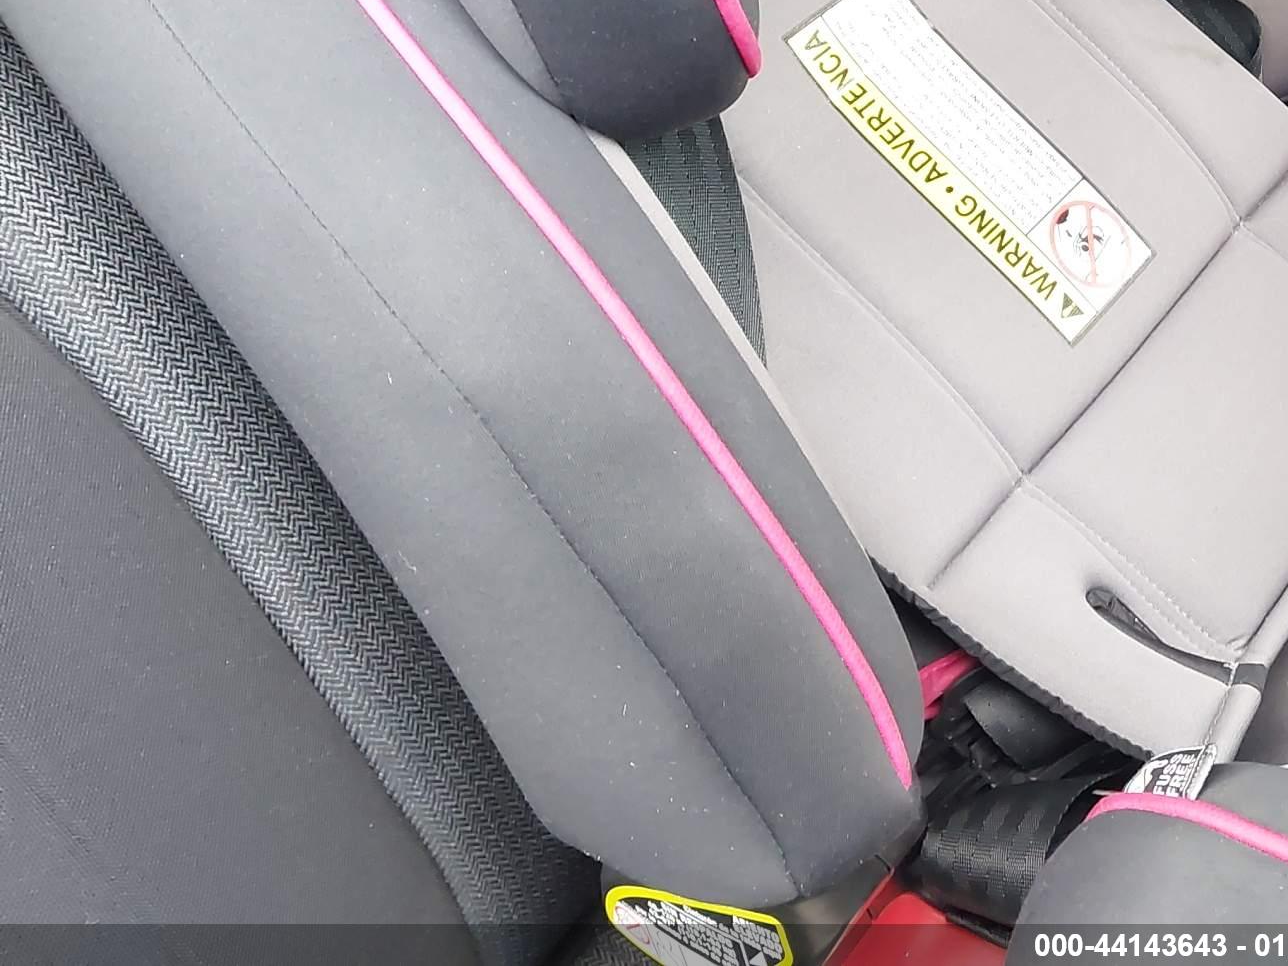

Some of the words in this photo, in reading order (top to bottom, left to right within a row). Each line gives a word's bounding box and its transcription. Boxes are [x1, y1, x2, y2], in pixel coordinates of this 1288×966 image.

[803, 29, 949, 184] ADVERTENCIA
[954, 194, 1058, 301] WARNING
[1152, 753, 1184, 795] FUSS
[1165, 753, 1196, 798] FREE
